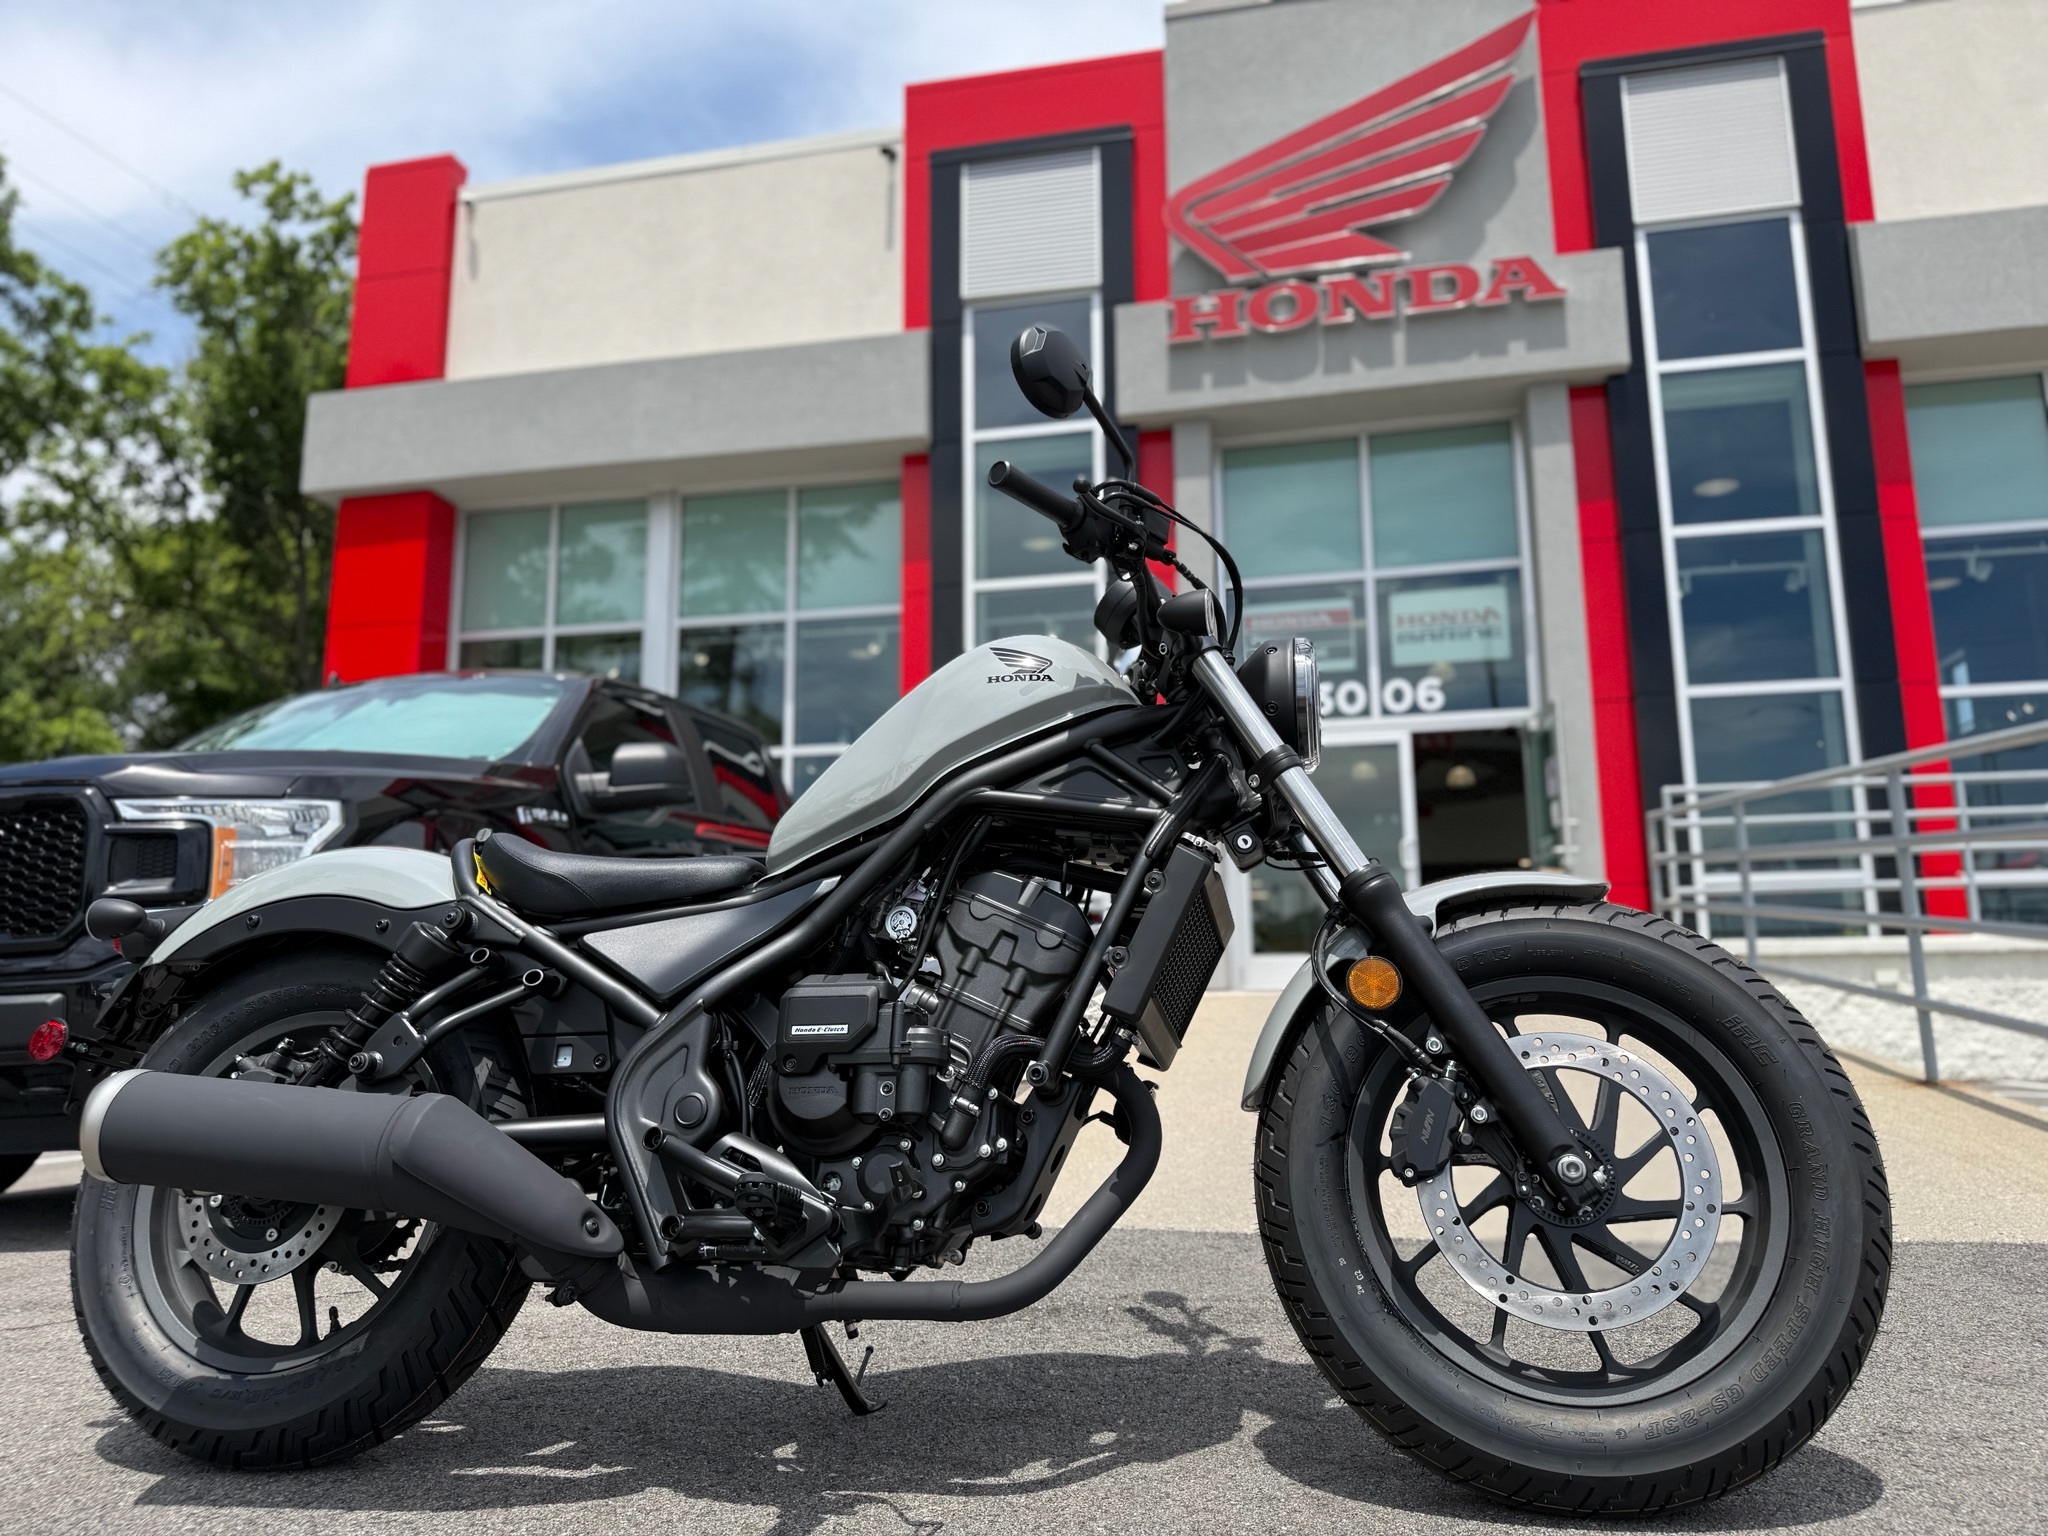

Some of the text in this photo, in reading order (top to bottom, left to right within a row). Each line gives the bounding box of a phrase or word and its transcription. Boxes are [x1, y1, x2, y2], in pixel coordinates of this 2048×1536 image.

[1168, 255, 1567, 344] HONDA
[987, 673, 1056, 684] HONDA
[244, 984, 307, 1015] SPEED
[787, 1085, 839, 1095] HONDA
[1352, 1267, 1366, 1283] G2
[1644, 1101, 1831, 1441] GRAND HIGH SPEED GS-23F
[1470, 1405, 1520, 1428] ROTATION
